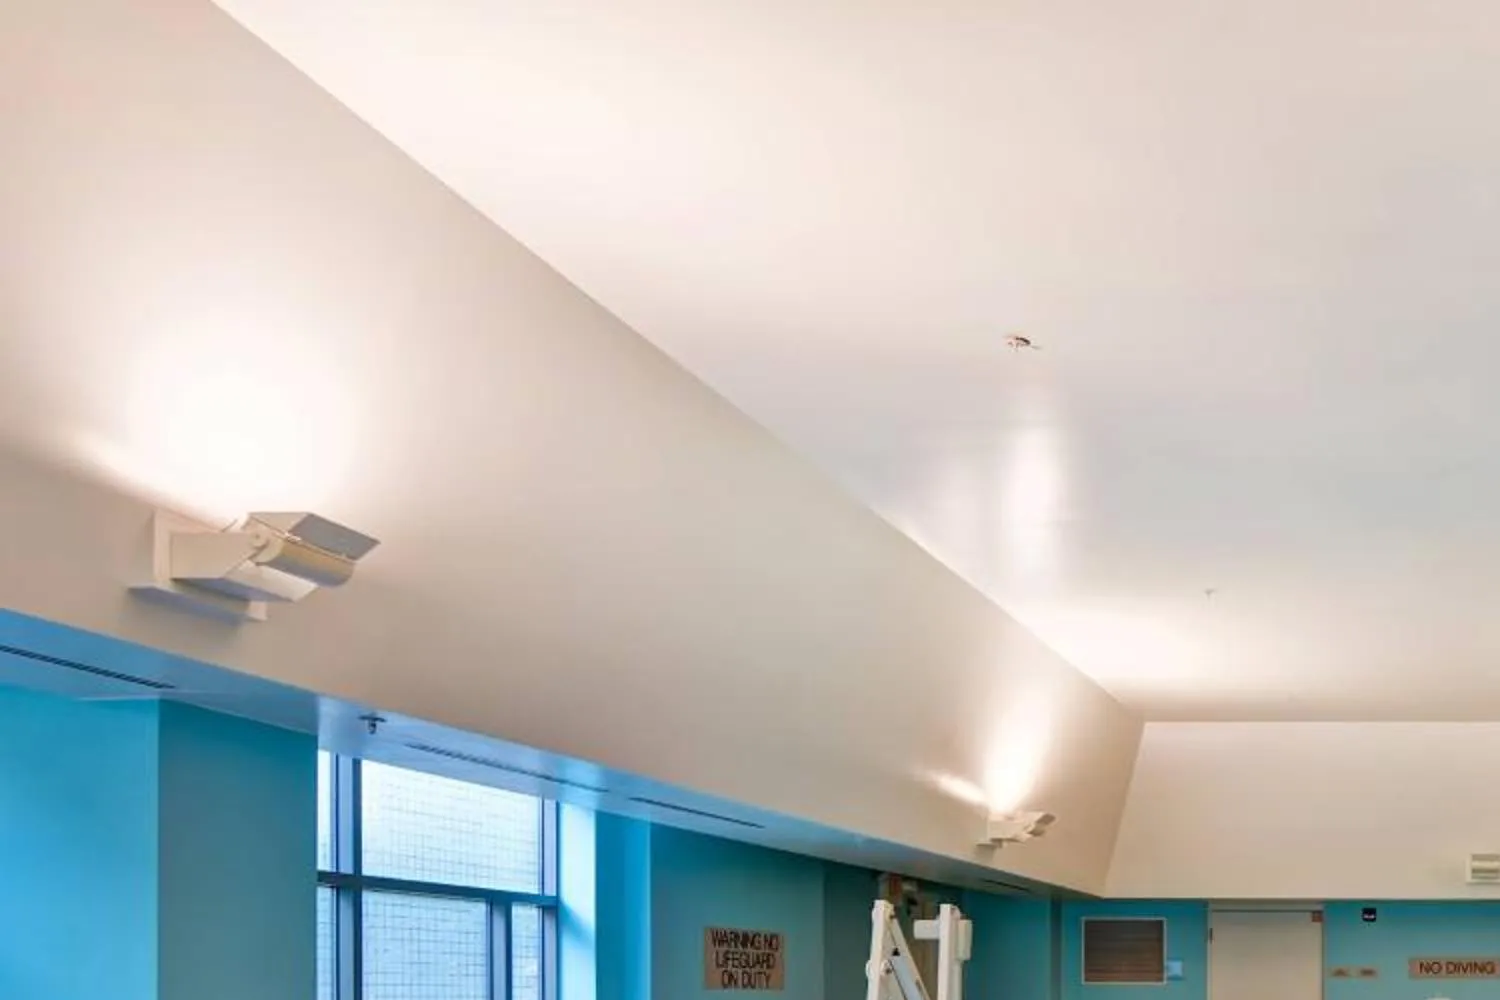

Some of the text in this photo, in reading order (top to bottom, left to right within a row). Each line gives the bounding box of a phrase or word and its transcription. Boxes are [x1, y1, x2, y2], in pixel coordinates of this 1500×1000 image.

[711, 928, 779, 952] WARNING NO
[715, 950, 776, 970] LIFEGUARD
[1419, 961, 1496, 975] NO DIVING
[722, 969, 771, 990] ON DUTY
